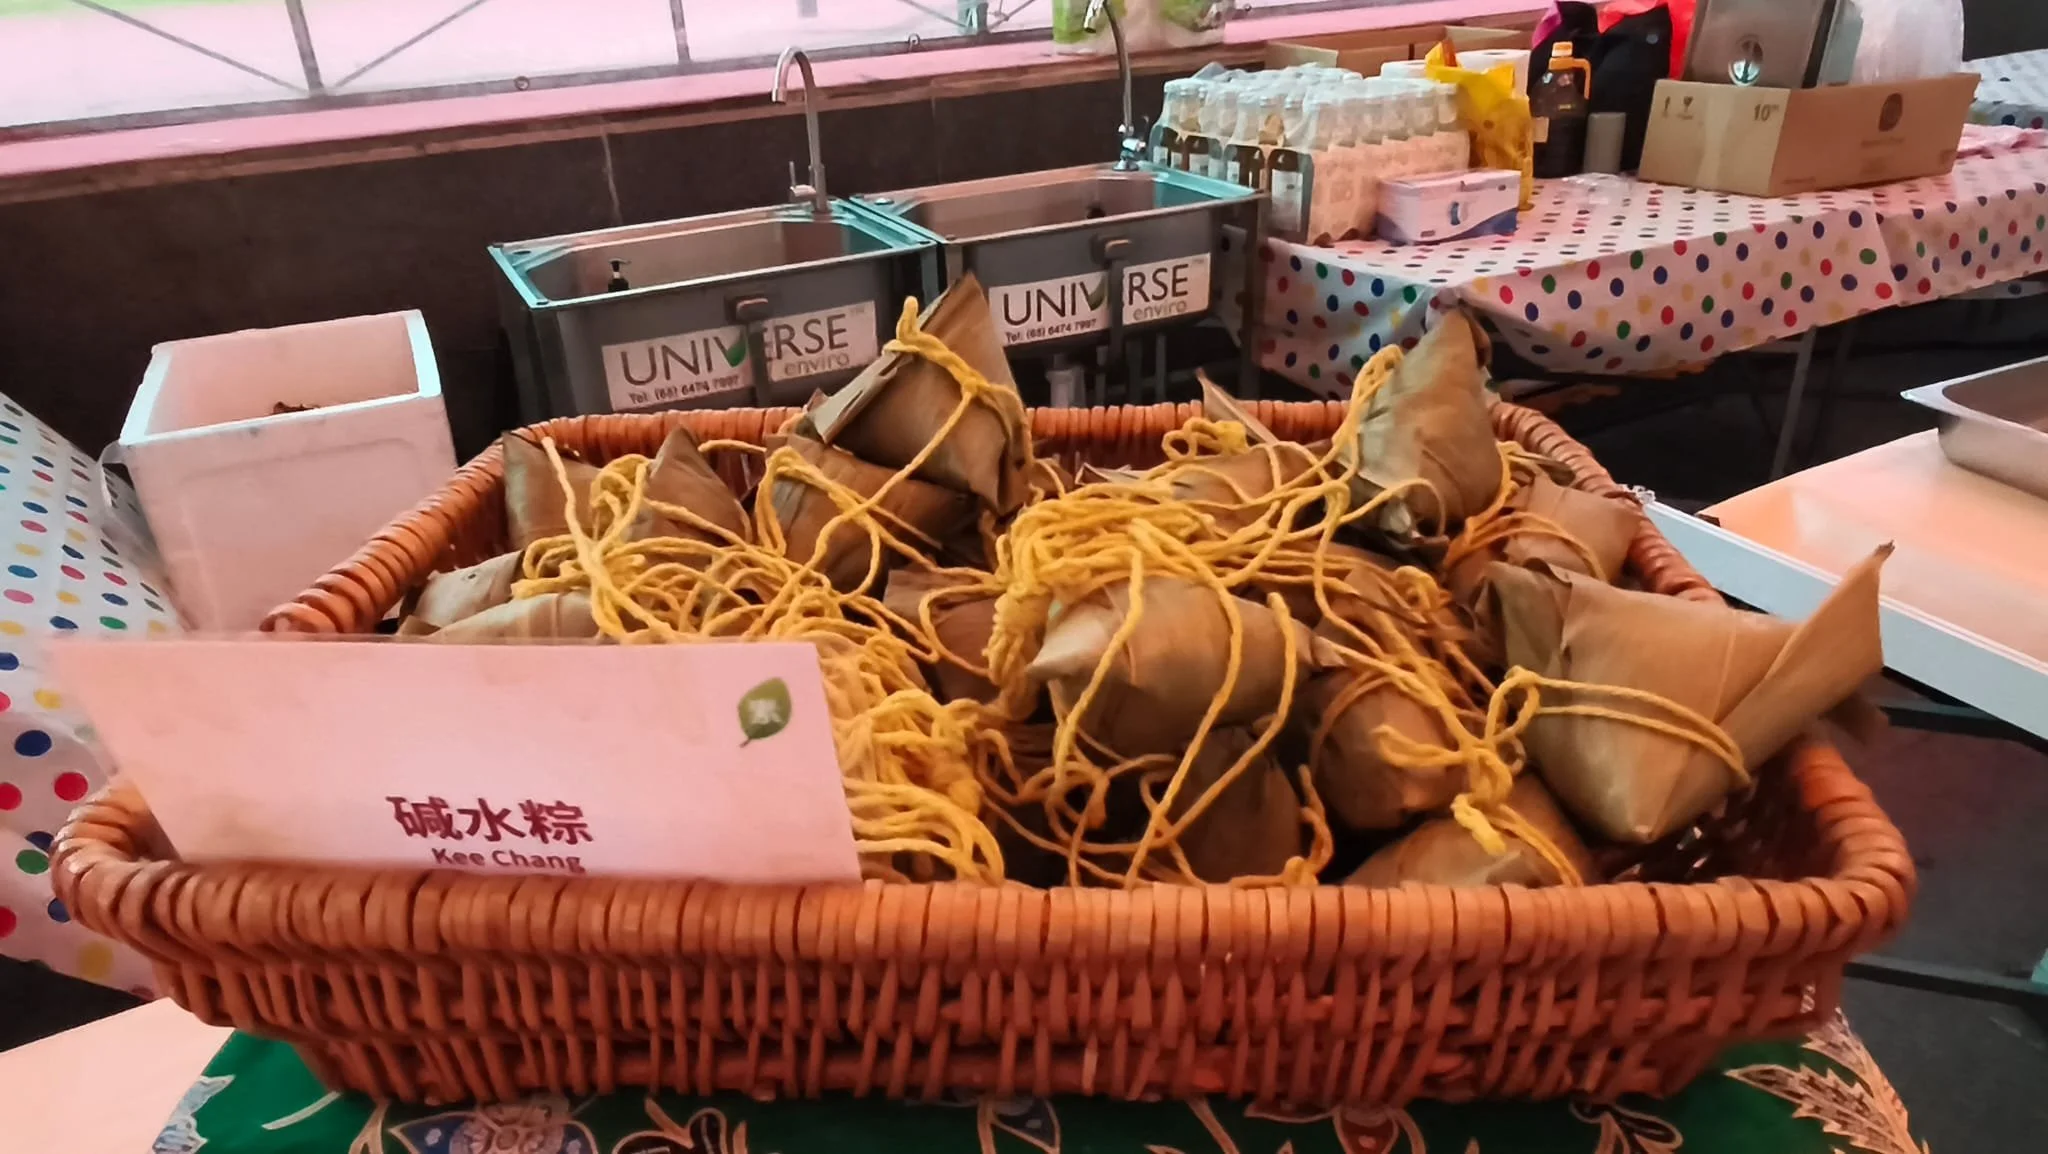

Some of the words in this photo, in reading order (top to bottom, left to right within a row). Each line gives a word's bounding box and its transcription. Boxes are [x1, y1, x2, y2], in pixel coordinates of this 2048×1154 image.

[1003, 263, 1189, 326] UNIVRSE
[1133, 300, 1187, 321] enviro
[1048, 323, 1072, 335] 6474
[784, 353, 850, 376] enviro
[386, 796, 594, 845] 碱水粽
[431, 848, 485, 866] Kee
[491, 849, 586, 874] Chang
